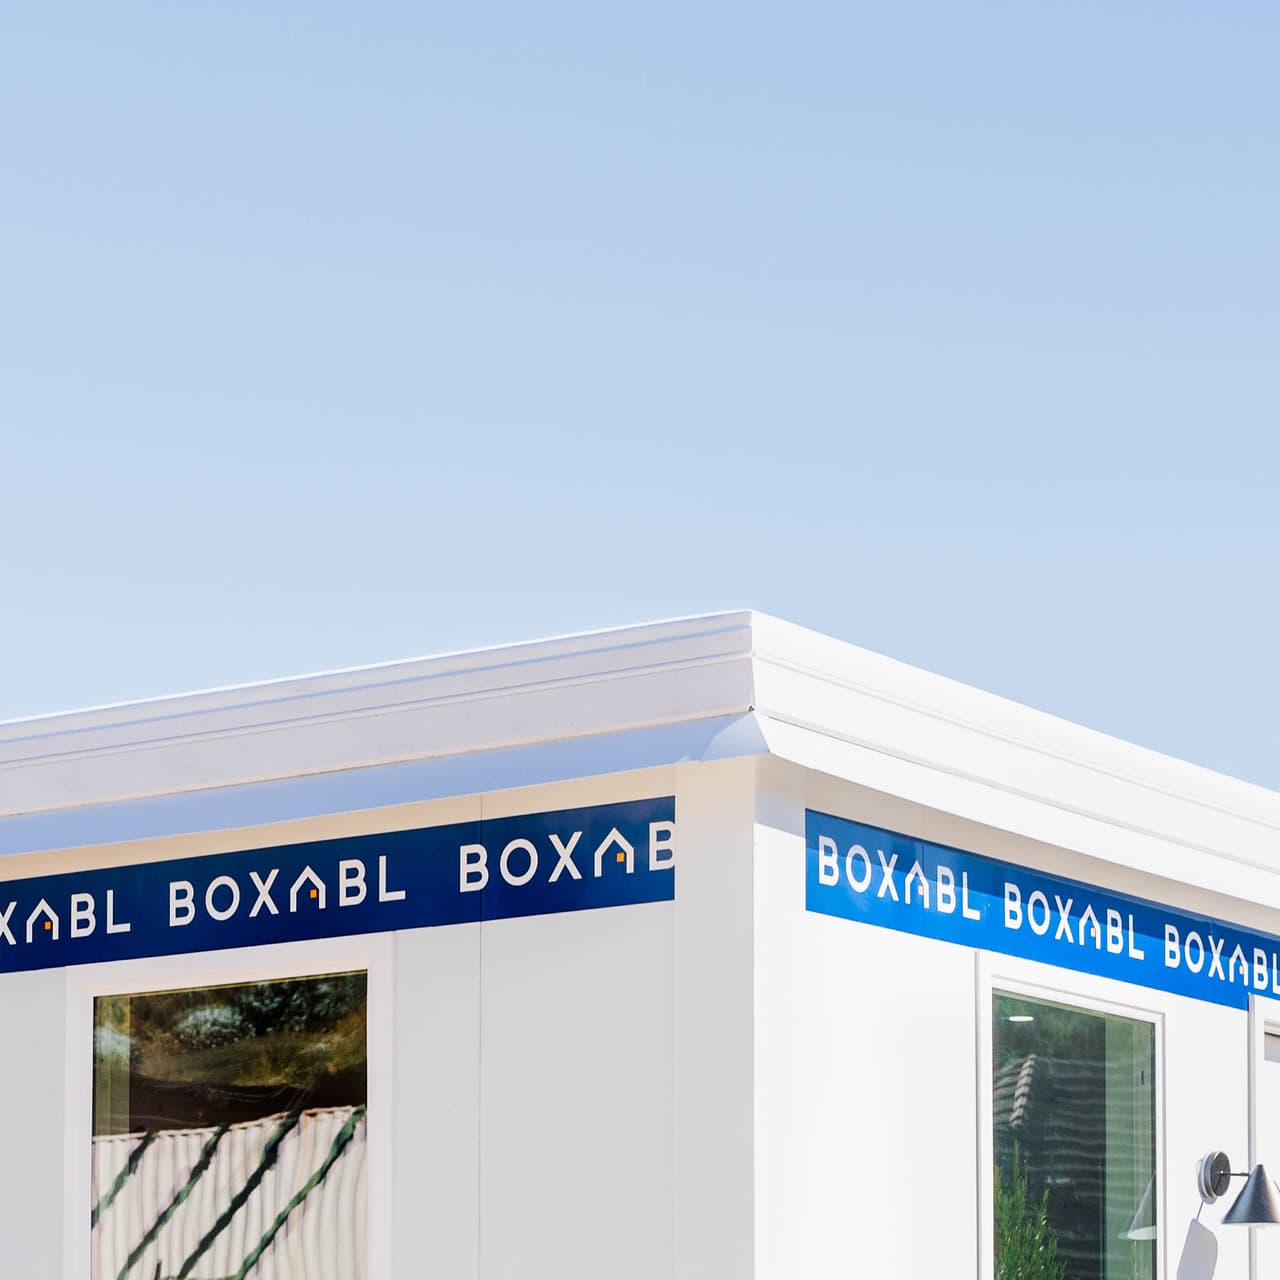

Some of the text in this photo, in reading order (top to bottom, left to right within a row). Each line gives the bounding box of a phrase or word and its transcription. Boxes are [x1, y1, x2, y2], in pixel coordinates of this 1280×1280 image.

[170, 856, 406, 927] BOXABL
[460, 821, 676, 893] BOXAB
[818, 836, 981, 921] BOXABL
[1004, 882, 1145, 961] BOXABL
